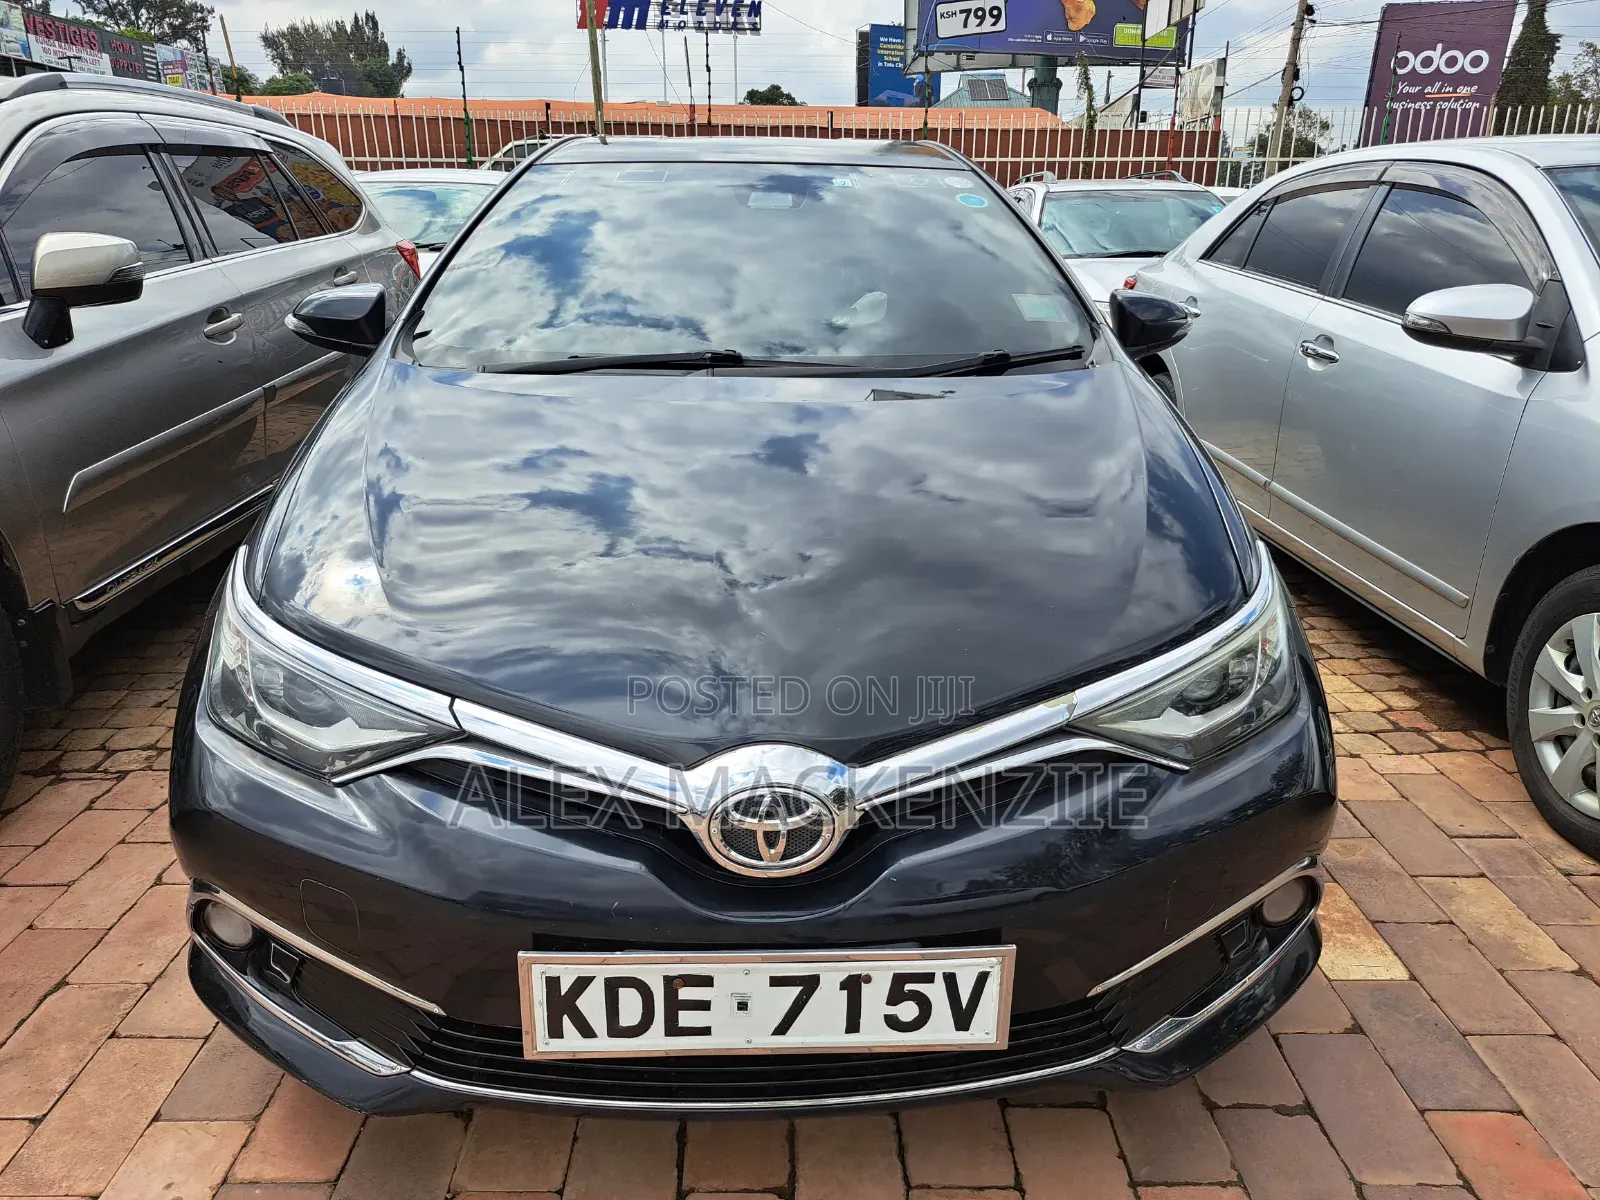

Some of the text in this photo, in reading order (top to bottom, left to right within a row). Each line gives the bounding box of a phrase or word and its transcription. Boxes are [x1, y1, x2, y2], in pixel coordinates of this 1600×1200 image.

[660, 0, 762, 18] ELEVEN
[940, 6, 1003, 29] KSH 799
[23, 13, 99, 51] VESTIGES
[57, 41, 75, 53] MAIN
[74, 45, 104, 60] ENTRANCE
[110, 40, 136, 56] HOME
[110, 58, 144, 73] SUPPLIES
[1391, 43, 1489, 74] odoo
[1397, 81, 1478, 94] Your all in one
[1436, 97, 1480, 110] solution
[545, 970, 991, 1039] KDE 715V
